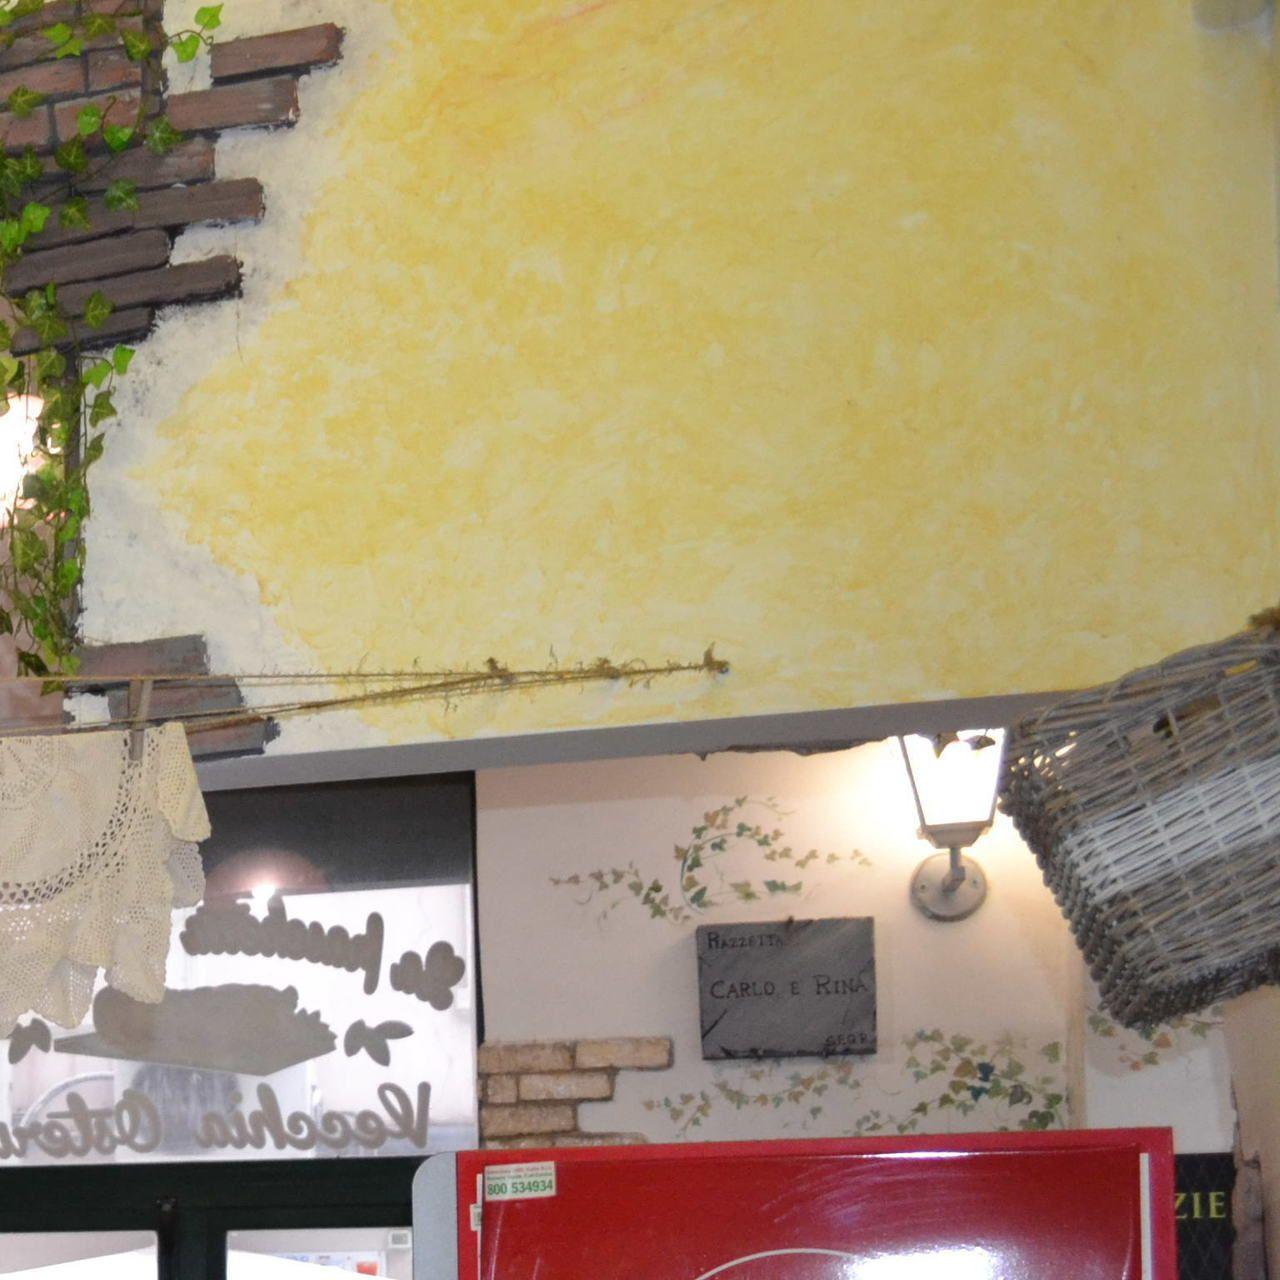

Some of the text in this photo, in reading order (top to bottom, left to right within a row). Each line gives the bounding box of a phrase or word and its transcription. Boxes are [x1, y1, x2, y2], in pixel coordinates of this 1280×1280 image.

[710, 975, 868, 998] CARLO E RINA
[487, 1183, 507, 1196] 800
